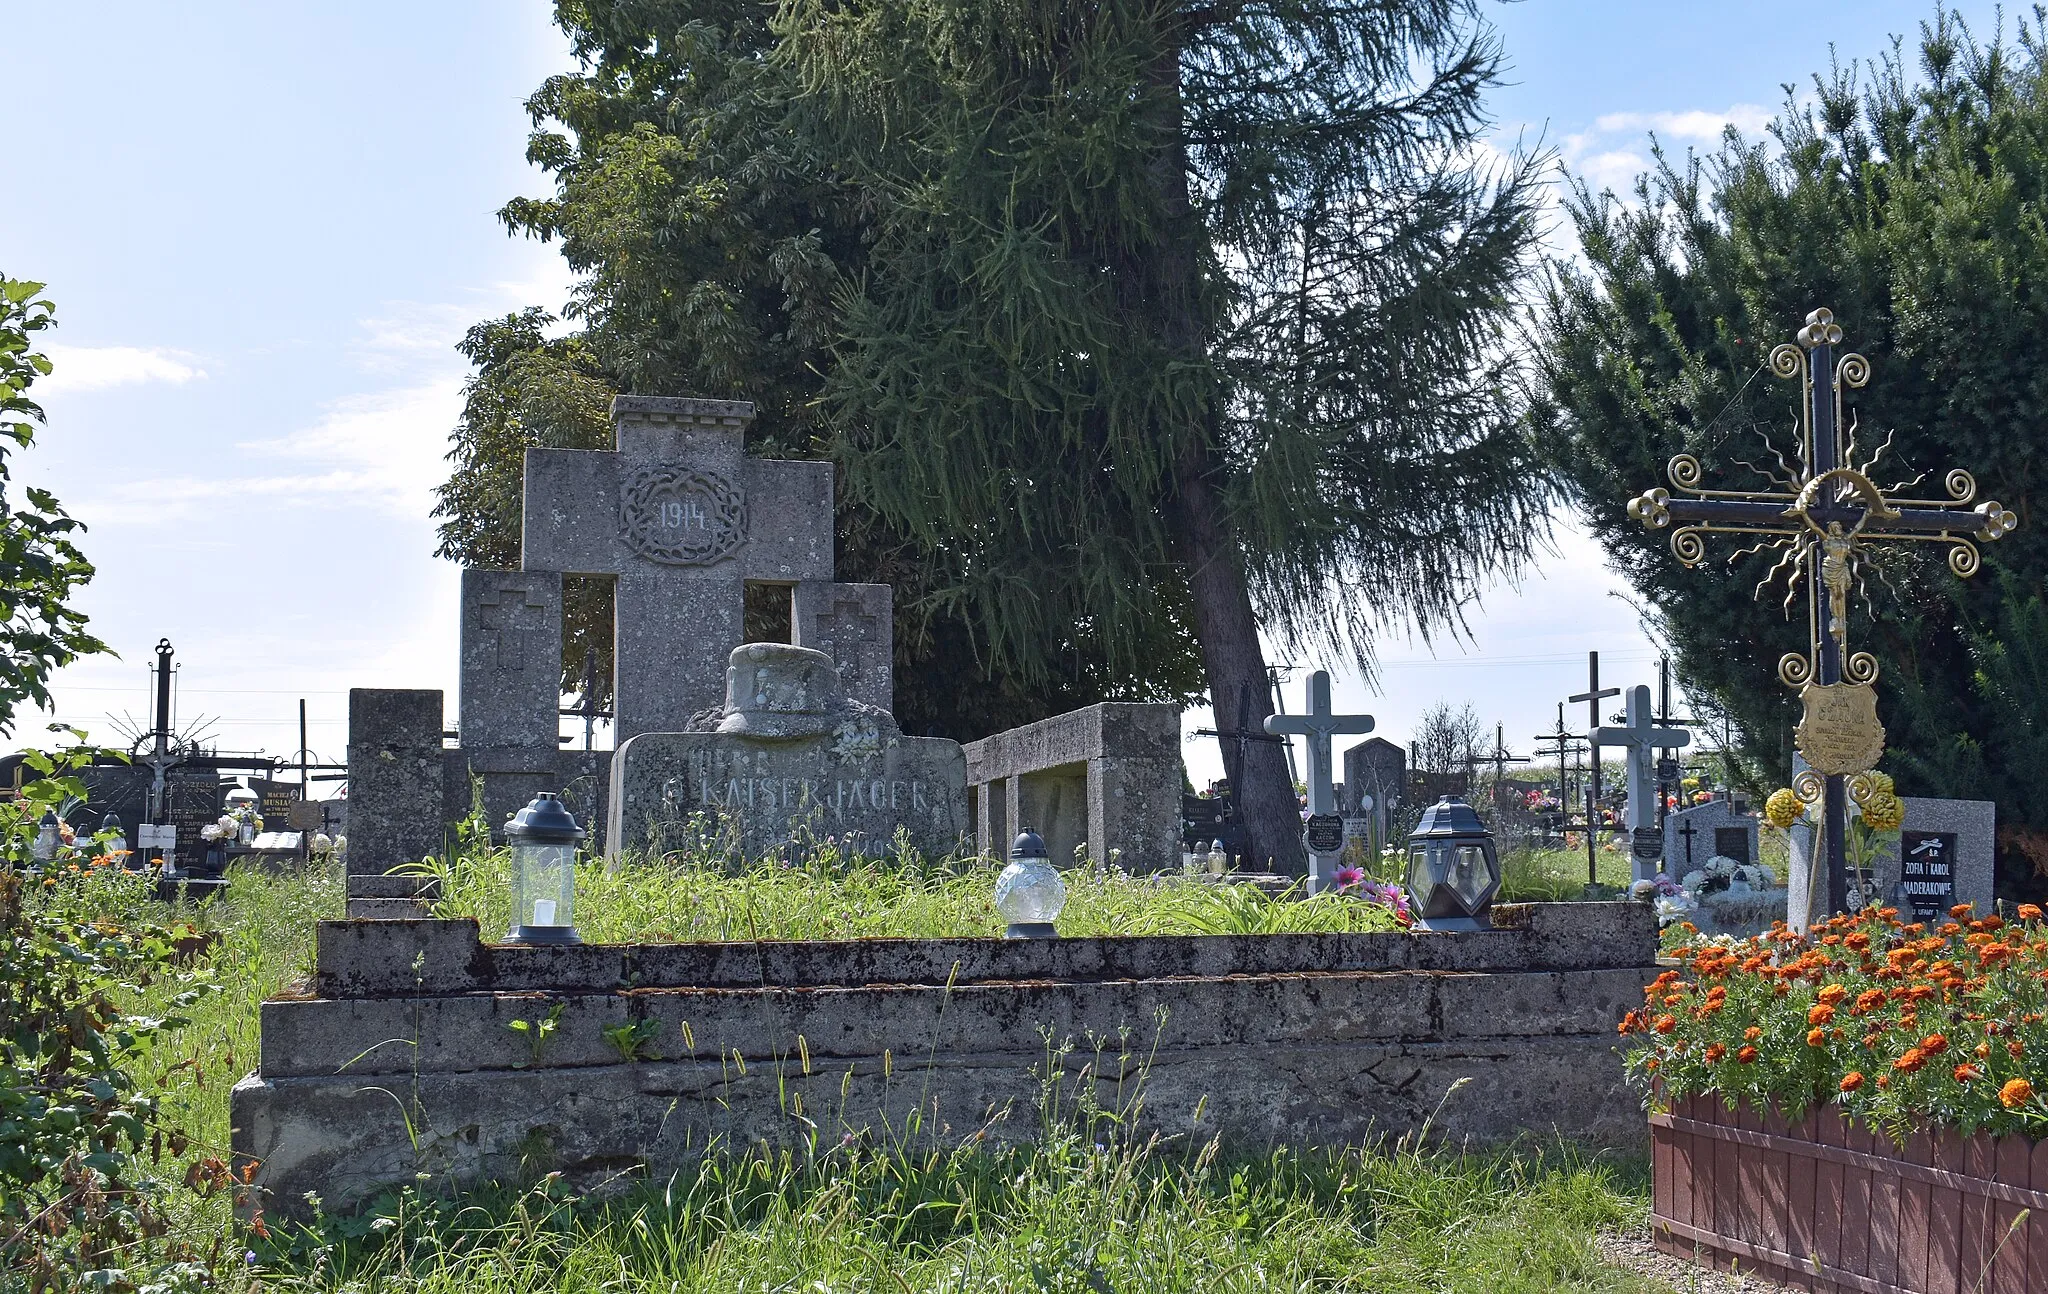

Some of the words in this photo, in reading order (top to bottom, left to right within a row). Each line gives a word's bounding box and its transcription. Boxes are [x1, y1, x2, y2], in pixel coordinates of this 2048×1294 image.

[661, 501, 706, 529] 1914
[1905, 862, 1924, 875] ZOFIA
[1930, 863, 1950, 876] KAROL
